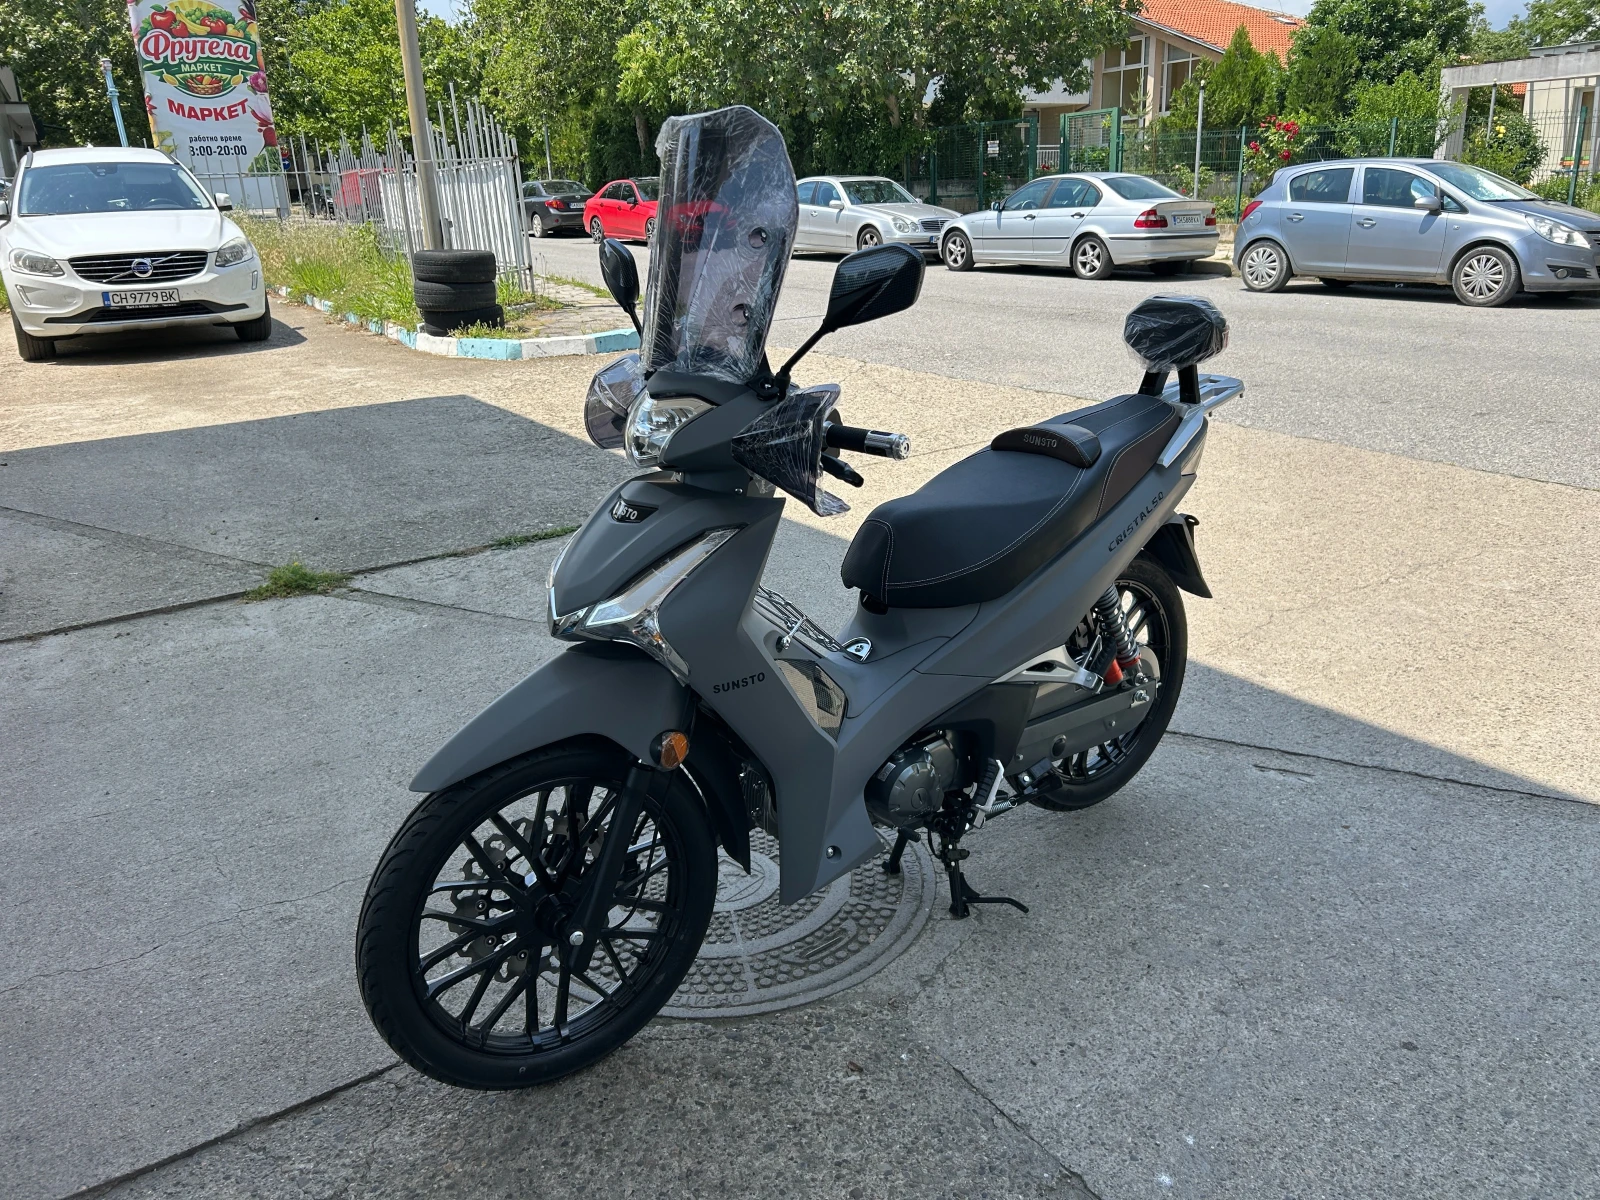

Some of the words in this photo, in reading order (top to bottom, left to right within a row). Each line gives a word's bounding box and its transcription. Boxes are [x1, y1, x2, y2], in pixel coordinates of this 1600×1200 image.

[142, 32, 251, 62] Фрутела
[180, 63, 223, 72] МАРКЕТ
[167, 98, 249, 122] МАРКЕТ
[188, 135, 218, 144] работно
[220, 135, 242, 143] време
[130, 291, 159, 304] 9779
[160, 290, 177, 302] BK
[1023, 433, 1058, 449] SUNSTO
[712, 671, 766, 695] SUNSTO
